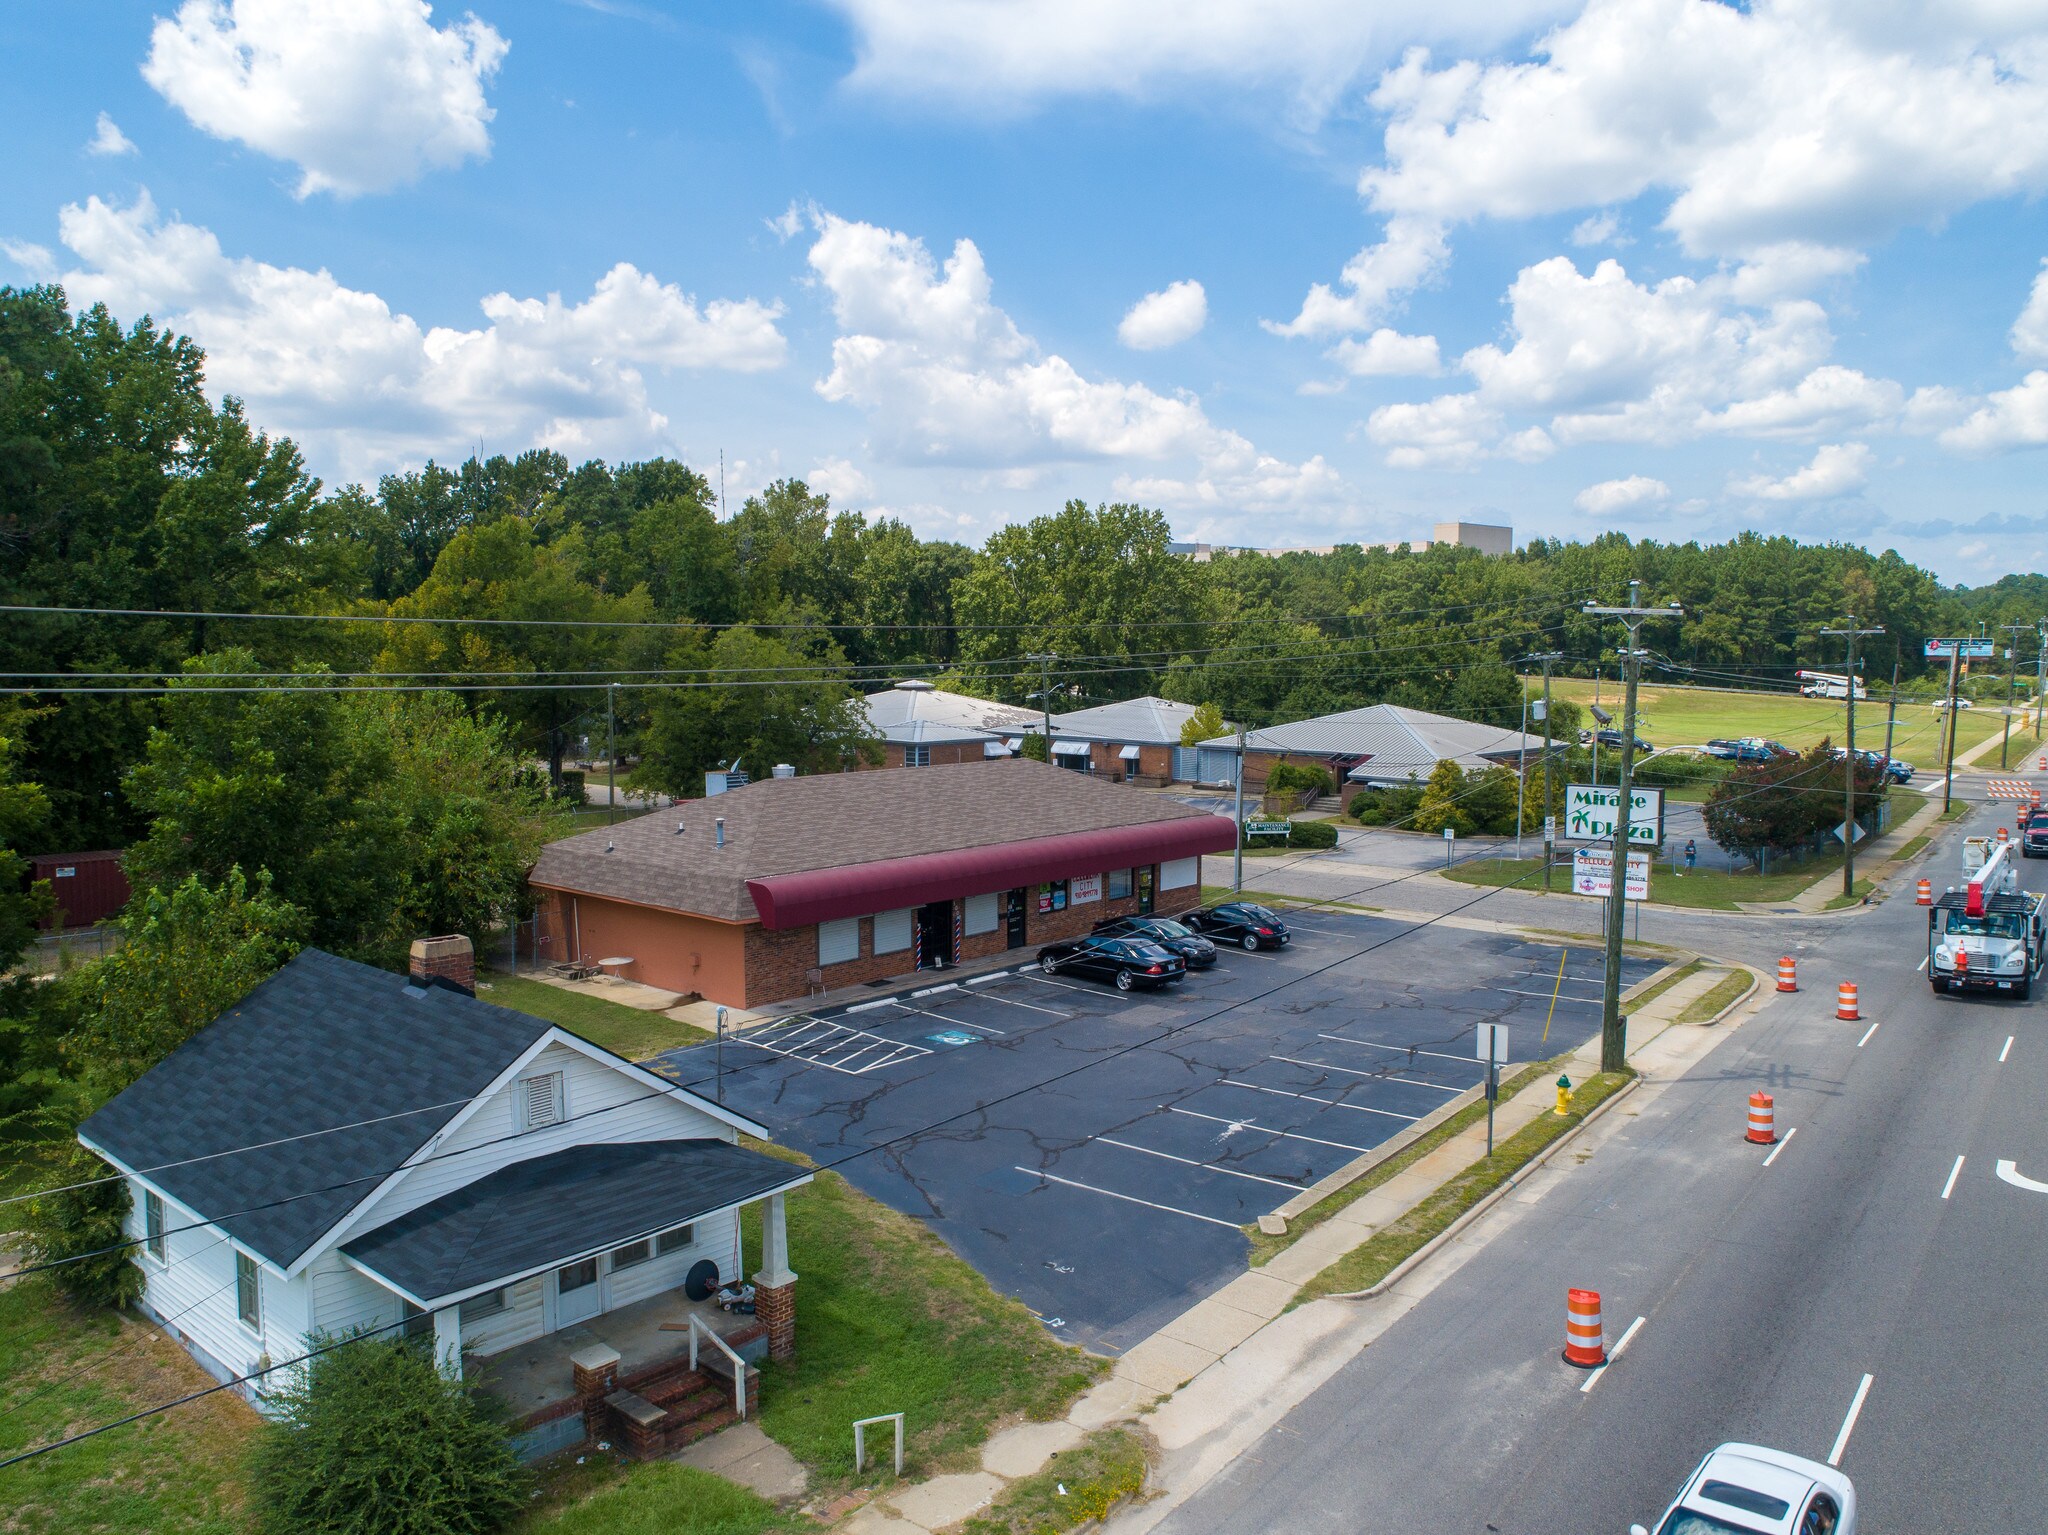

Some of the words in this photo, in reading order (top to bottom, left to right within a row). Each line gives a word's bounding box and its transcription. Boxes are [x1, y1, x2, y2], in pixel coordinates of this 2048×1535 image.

[1591, 821, 1654, 839] Plza
[1578, 857, 1613, 866] CELLULA
[1079, 881, 1093, 891] CITY
